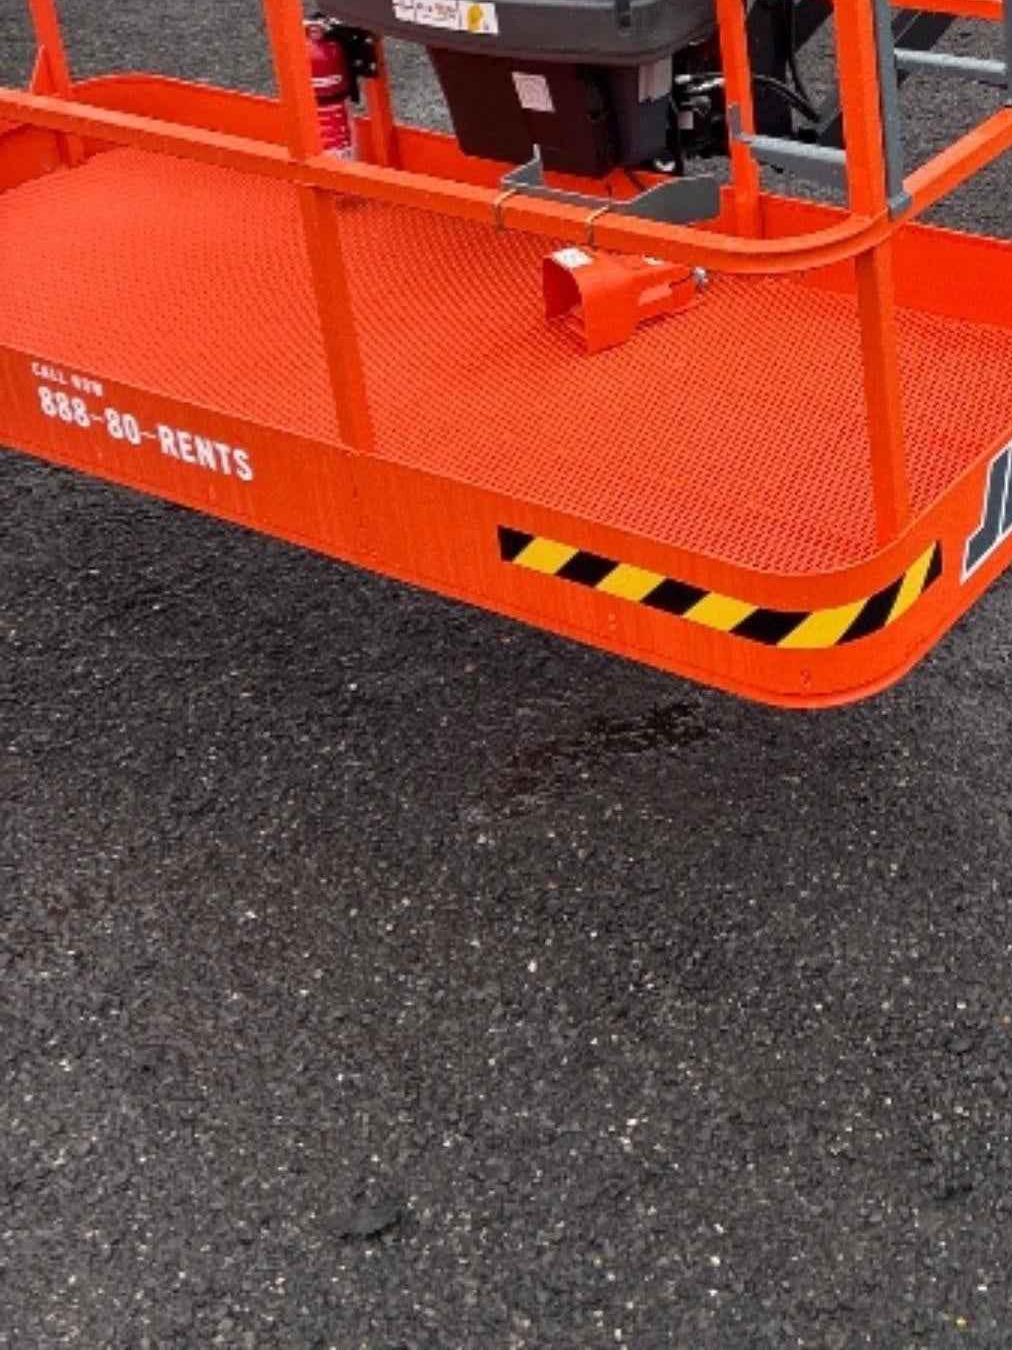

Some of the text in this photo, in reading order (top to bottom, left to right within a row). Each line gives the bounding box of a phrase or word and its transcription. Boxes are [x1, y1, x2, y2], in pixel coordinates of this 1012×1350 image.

[31, 362, 103, 396] CALL NOW
[38, 386, 253, 481] 888-80-RENTS
